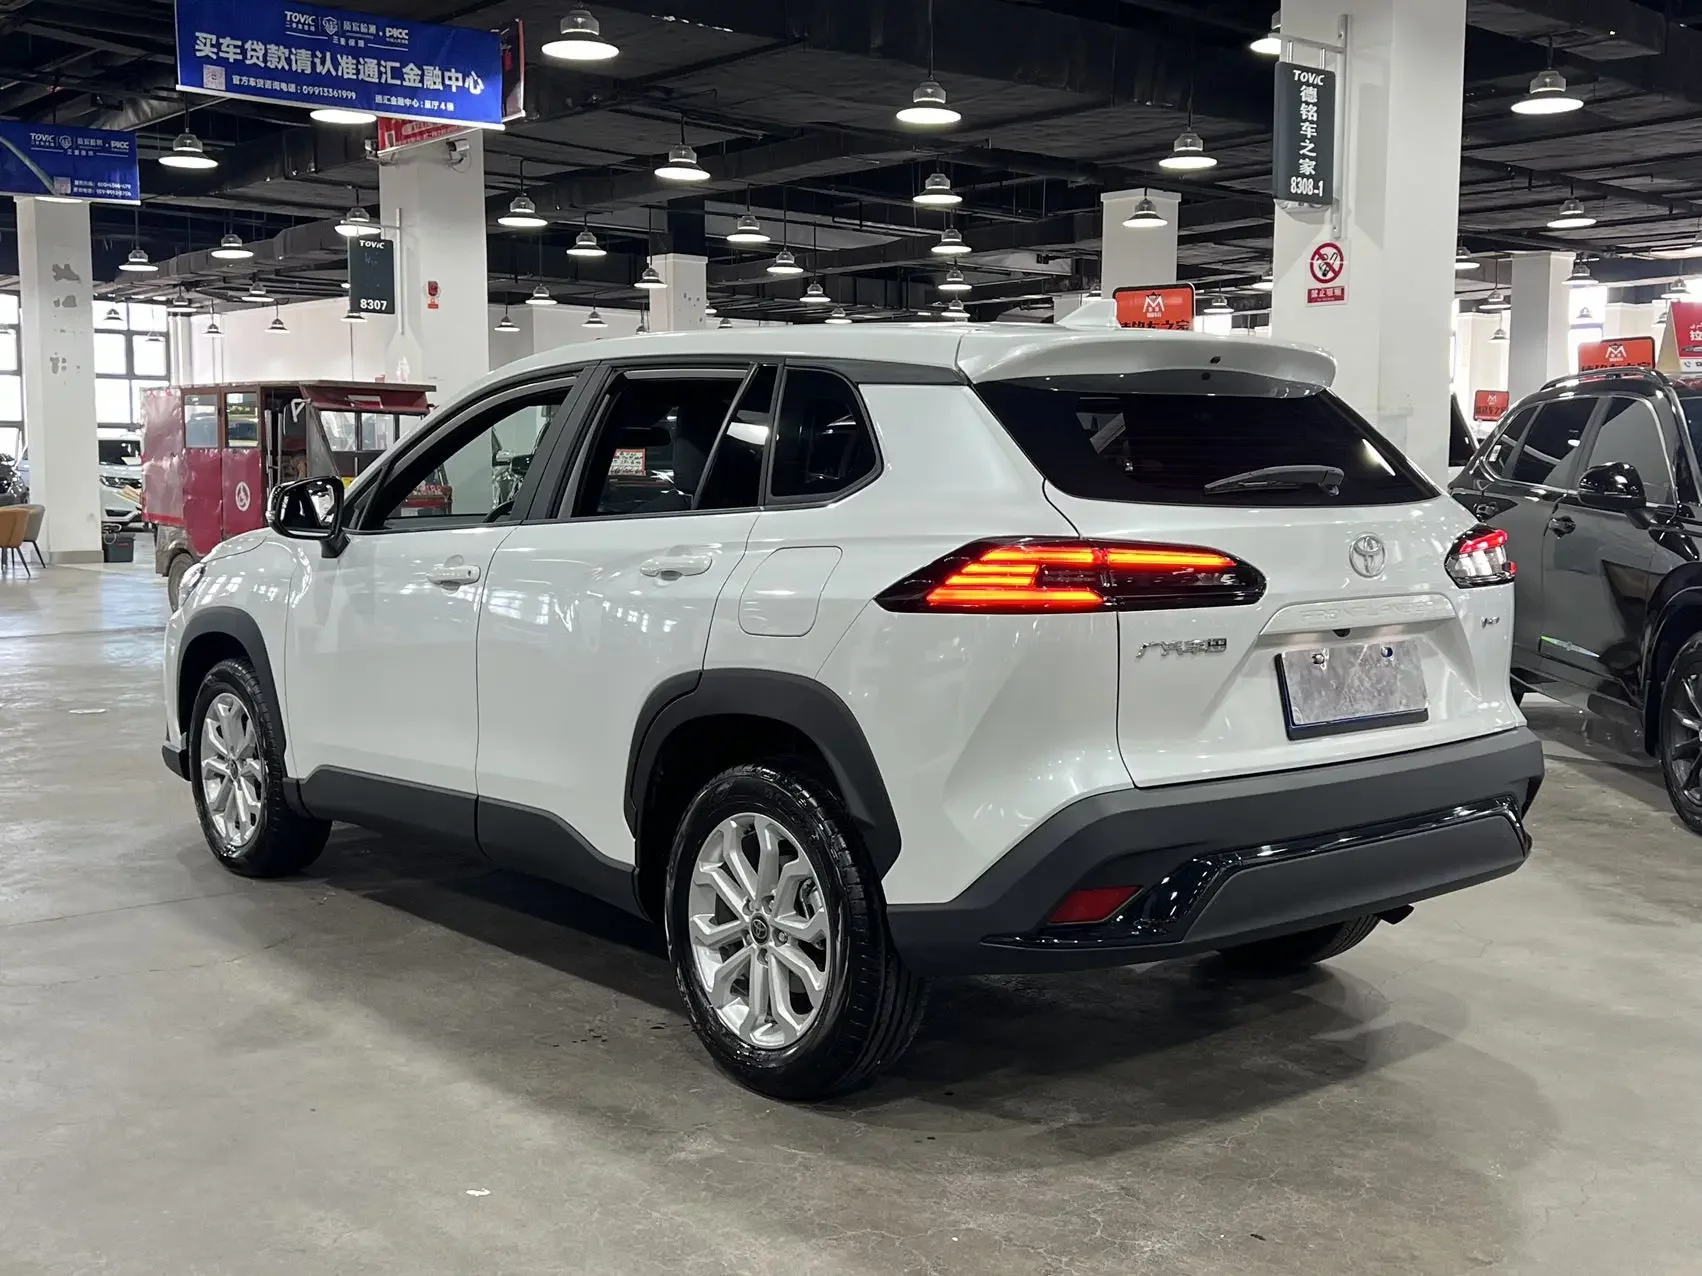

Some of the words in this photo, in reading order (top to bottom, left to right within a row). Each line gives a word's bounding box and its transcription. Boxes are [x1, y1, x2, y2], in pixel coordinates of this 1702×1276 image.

[284, 11, 316, 25] TOVIC
[385, 27, 409, 39] PICC
[195, 32, 485, 96] 买车贷款请认准通汇金融中心
[1293, 70, 1325, 86] TOVIC
[29, 132, 55, 142] TOVIC
[1299, 85, 1318, 176] 德铭车之家
[1290, 176, 1324, 197] 8308-1
[359, 239, 385, 249] TOVIC
[360, 298, 387, 311] 8307
